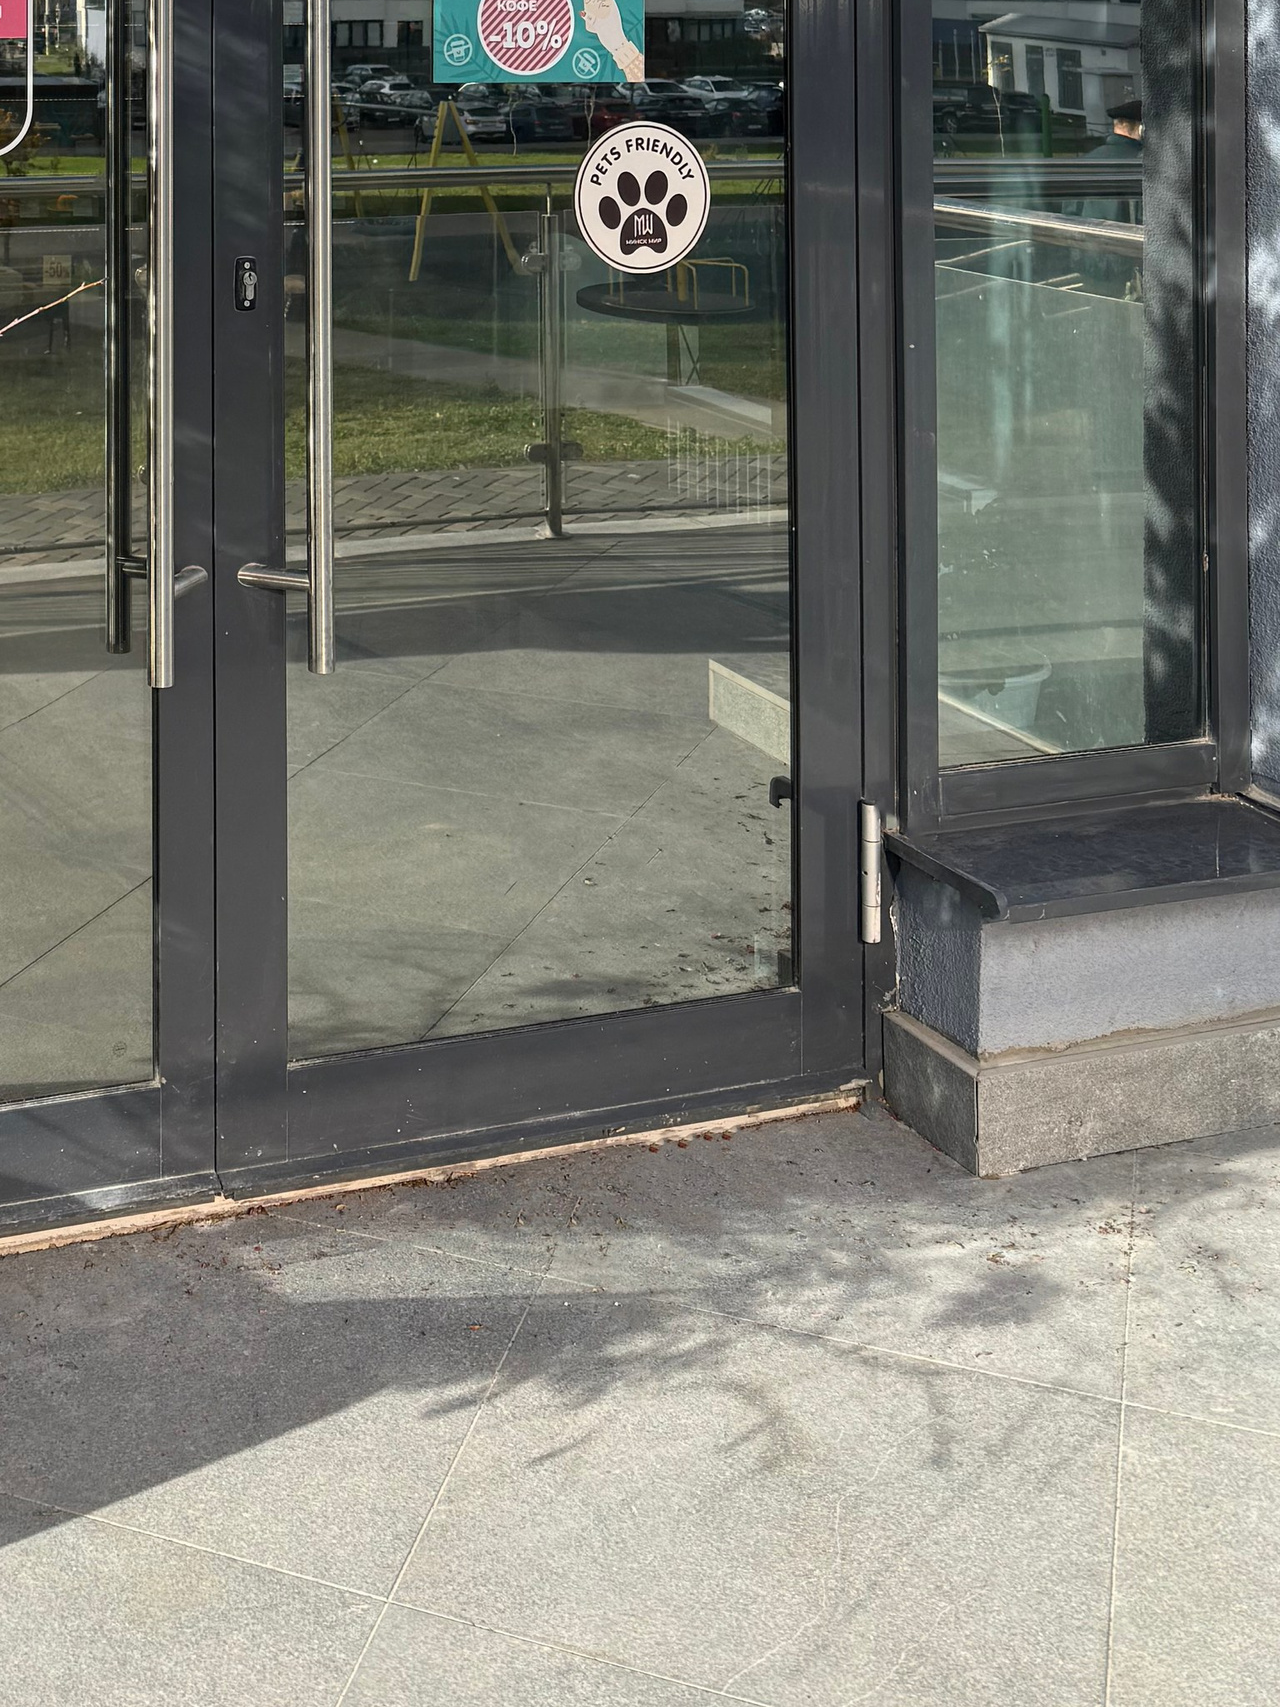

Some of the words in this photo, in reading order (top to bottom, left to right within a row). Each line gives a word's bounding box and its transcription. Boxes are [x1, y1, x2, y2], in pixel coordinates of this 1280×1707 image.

[496, 0, 538, 13] КОФЕ
[488, 20, 563, 50] -10%
[590, 146, 623, 186] PETS
[624, 137, 696, 181] FRIENDLY
